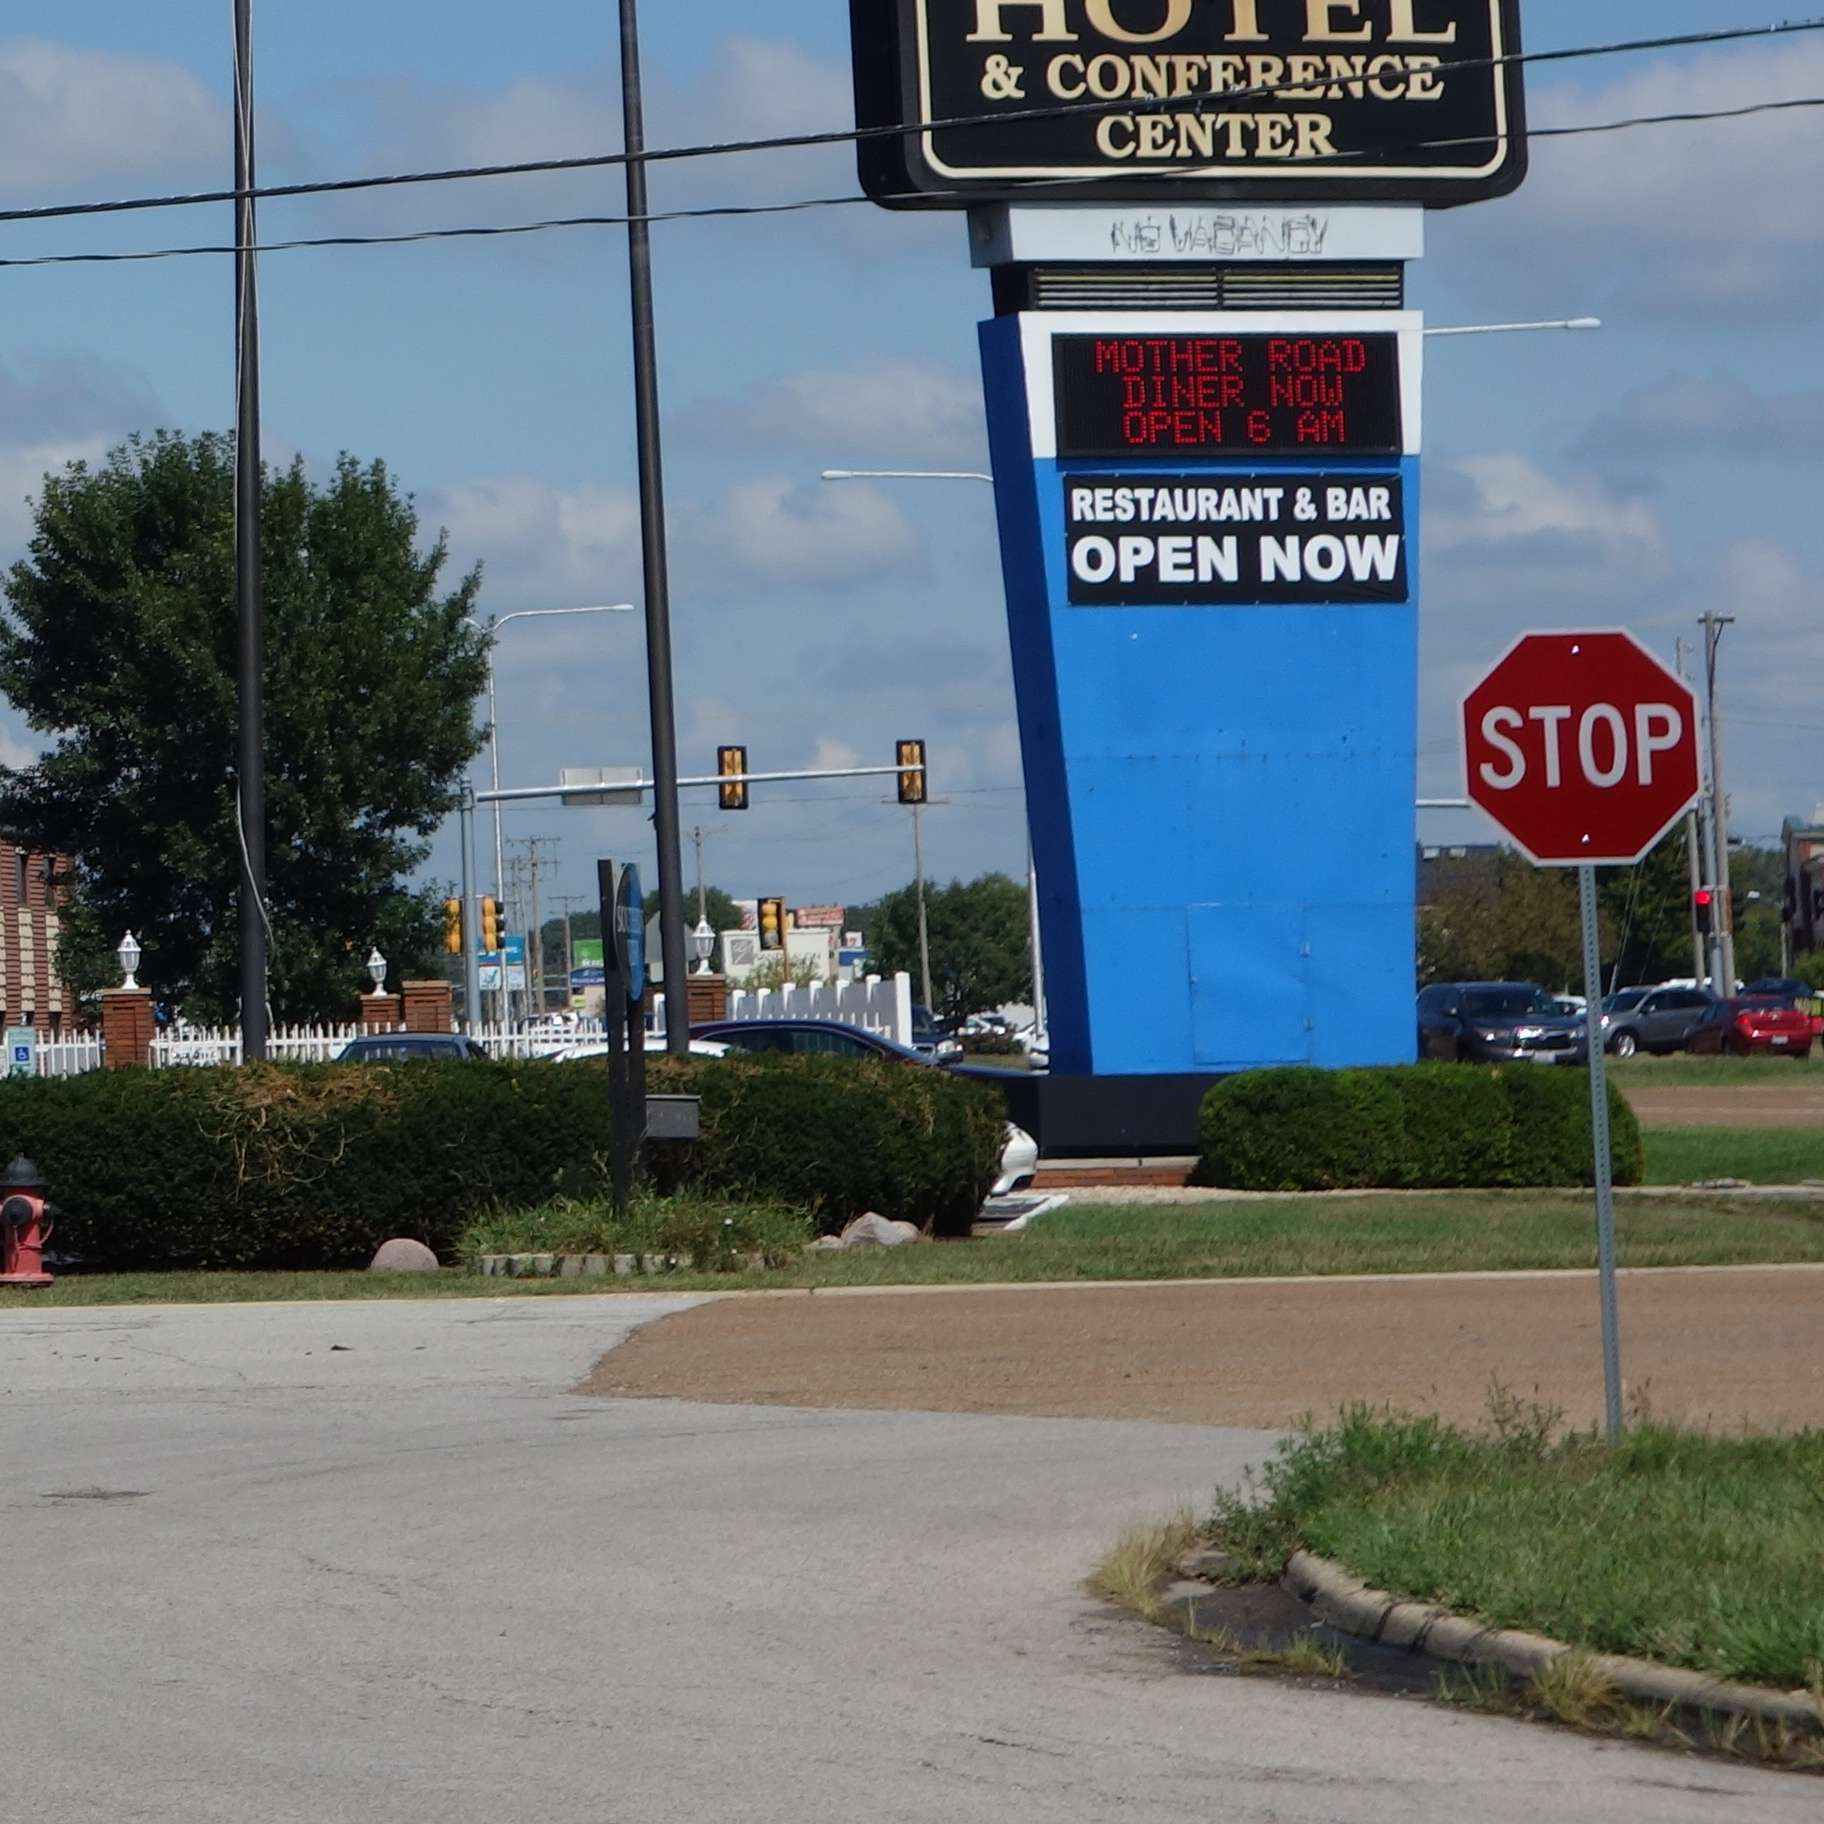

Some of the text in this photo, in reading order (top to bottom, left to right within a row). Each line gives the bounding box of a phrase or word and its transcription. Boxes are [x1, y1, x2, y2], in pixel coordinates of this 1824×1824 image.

[980, 53, 1445, 101] & CONFERENCE
[1095, 113, 1339, 159] CENTER
[1094, 339, 1366, 373] MOTHER ROAD
[1122, 375, 1344, 409] DINER NOW
[1122, 409, 1345, 444] OPEN 6 AM
[1071, 486, 1392, 522] RESTAURANT & BAR
[1071, 533, 1400, 583] OPEN NOW
[1479, 702, 1684, 791] STOP
